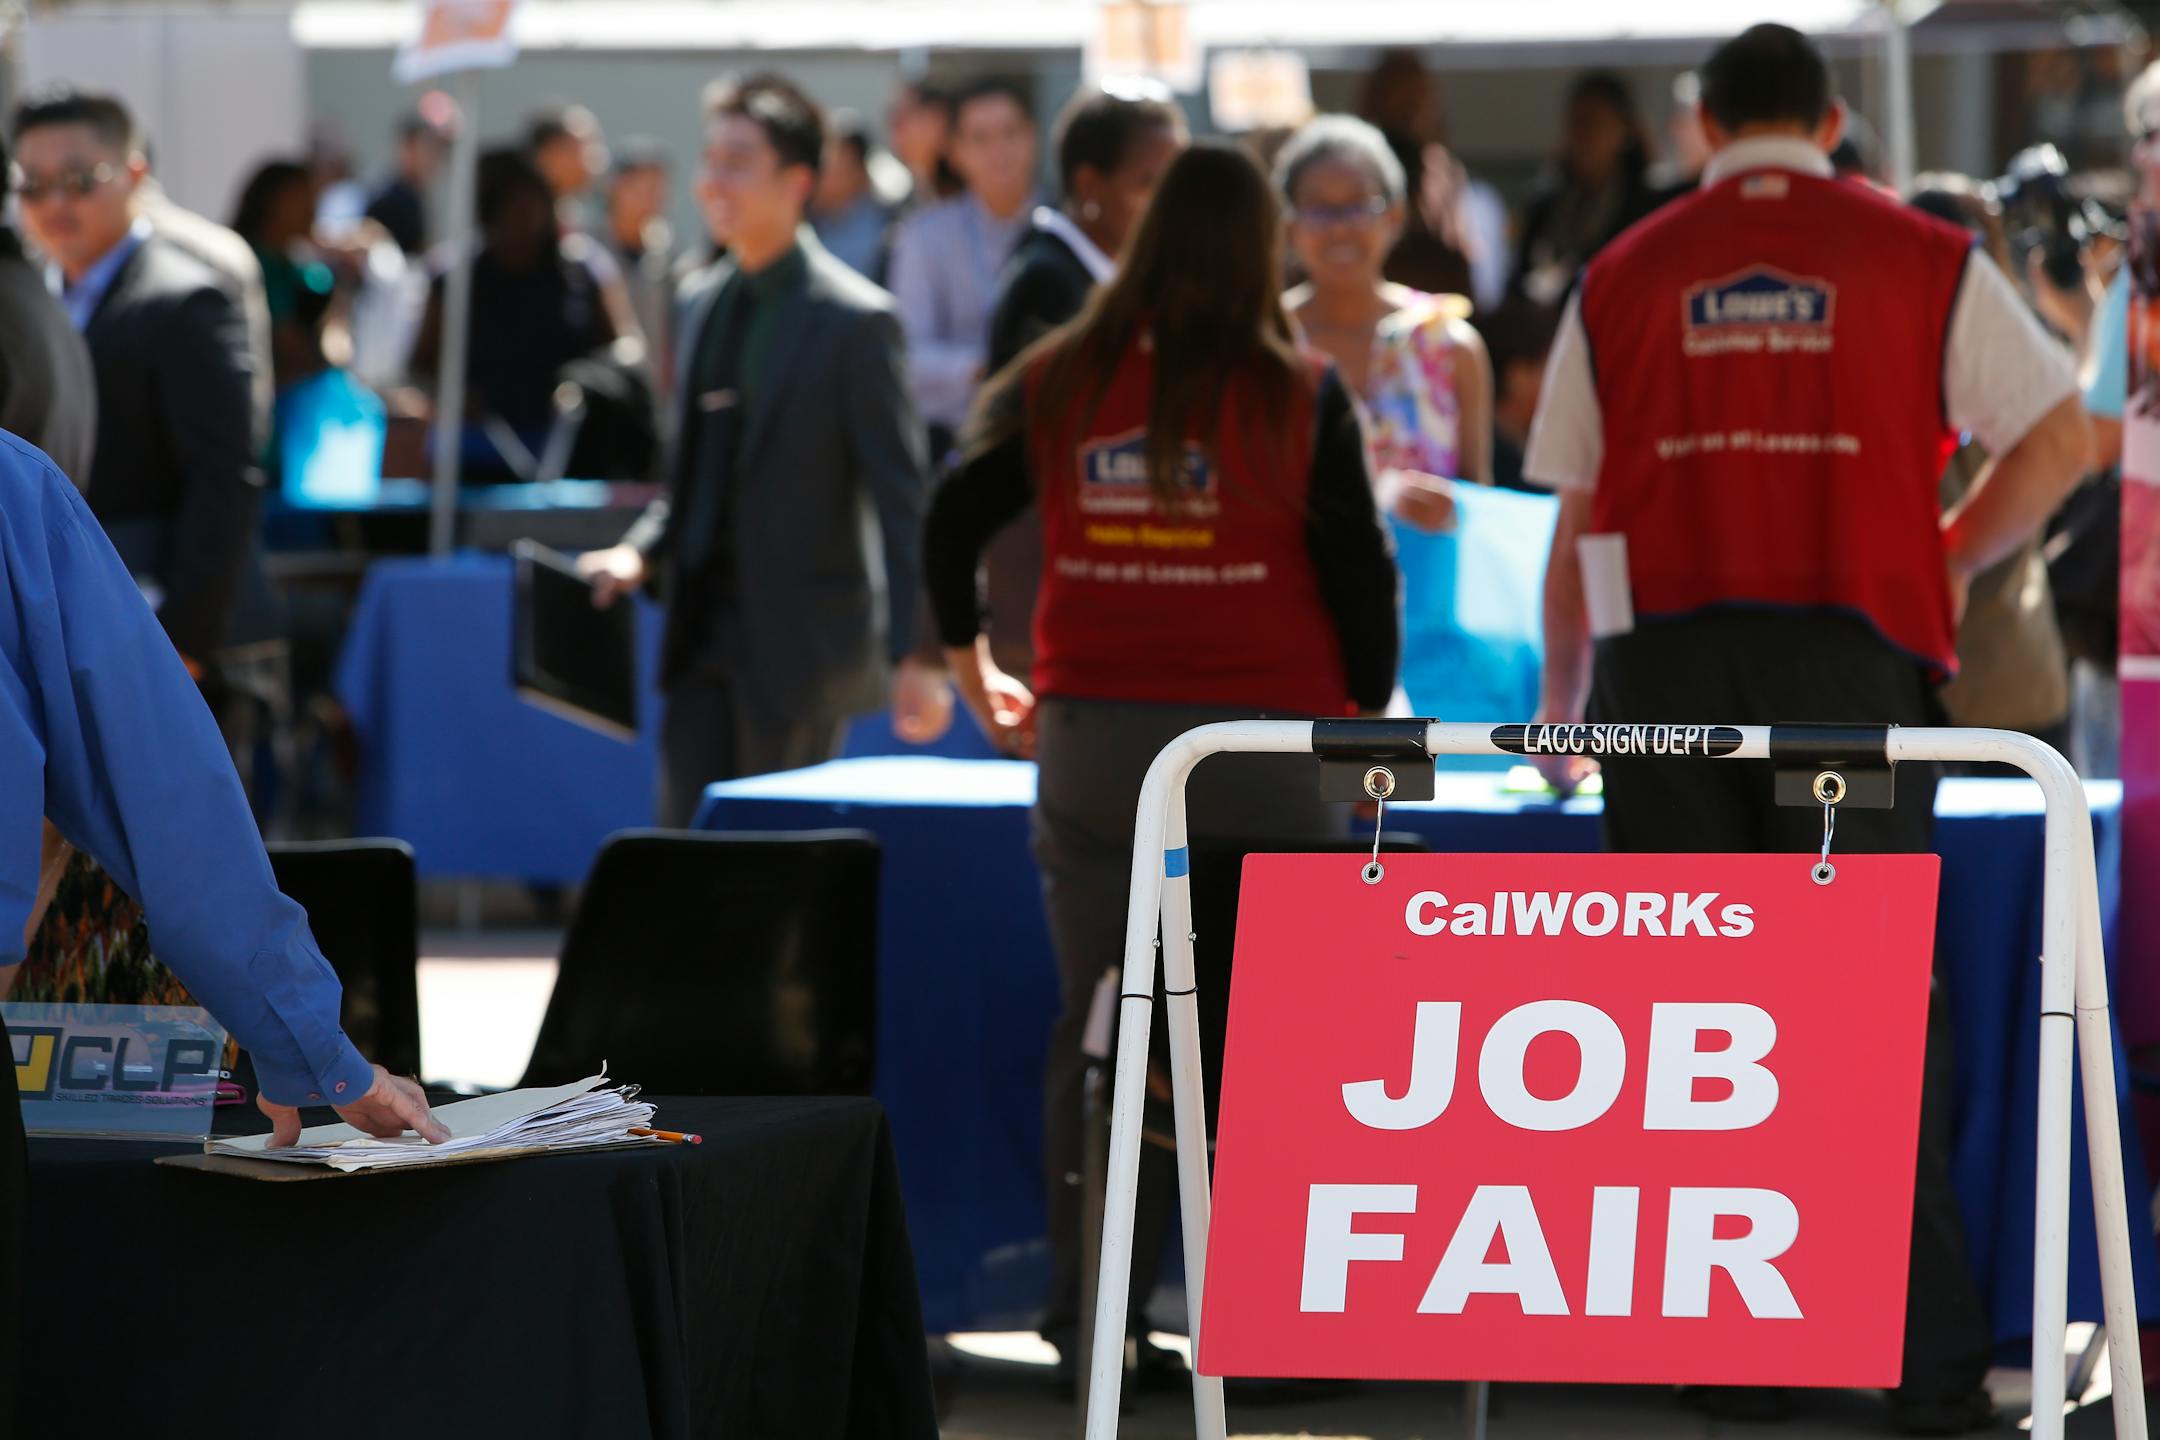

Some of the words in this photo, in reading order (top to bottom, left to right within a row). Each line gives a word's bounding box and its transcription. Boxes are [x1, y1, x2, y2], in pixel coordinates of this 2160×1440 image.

[1523, 724, 1585, 754] LACC
[1591, 725, 1647, 755] SIGN
[1653, 726, 1717, 756] DEPT
[1404, 890, 1756, 938] CalWORKs
[59, 1035, 216, 1092] CLP
[1341, 999, 1780, 1132] JOB
[55, 1092, 98, 1103] SKILLED
[101, 1093, 142, 1104] TRADES
[145, 1095, 207, 1106] SOLUTIONS
[1299, 1183, 1805, 1320] FAIR
